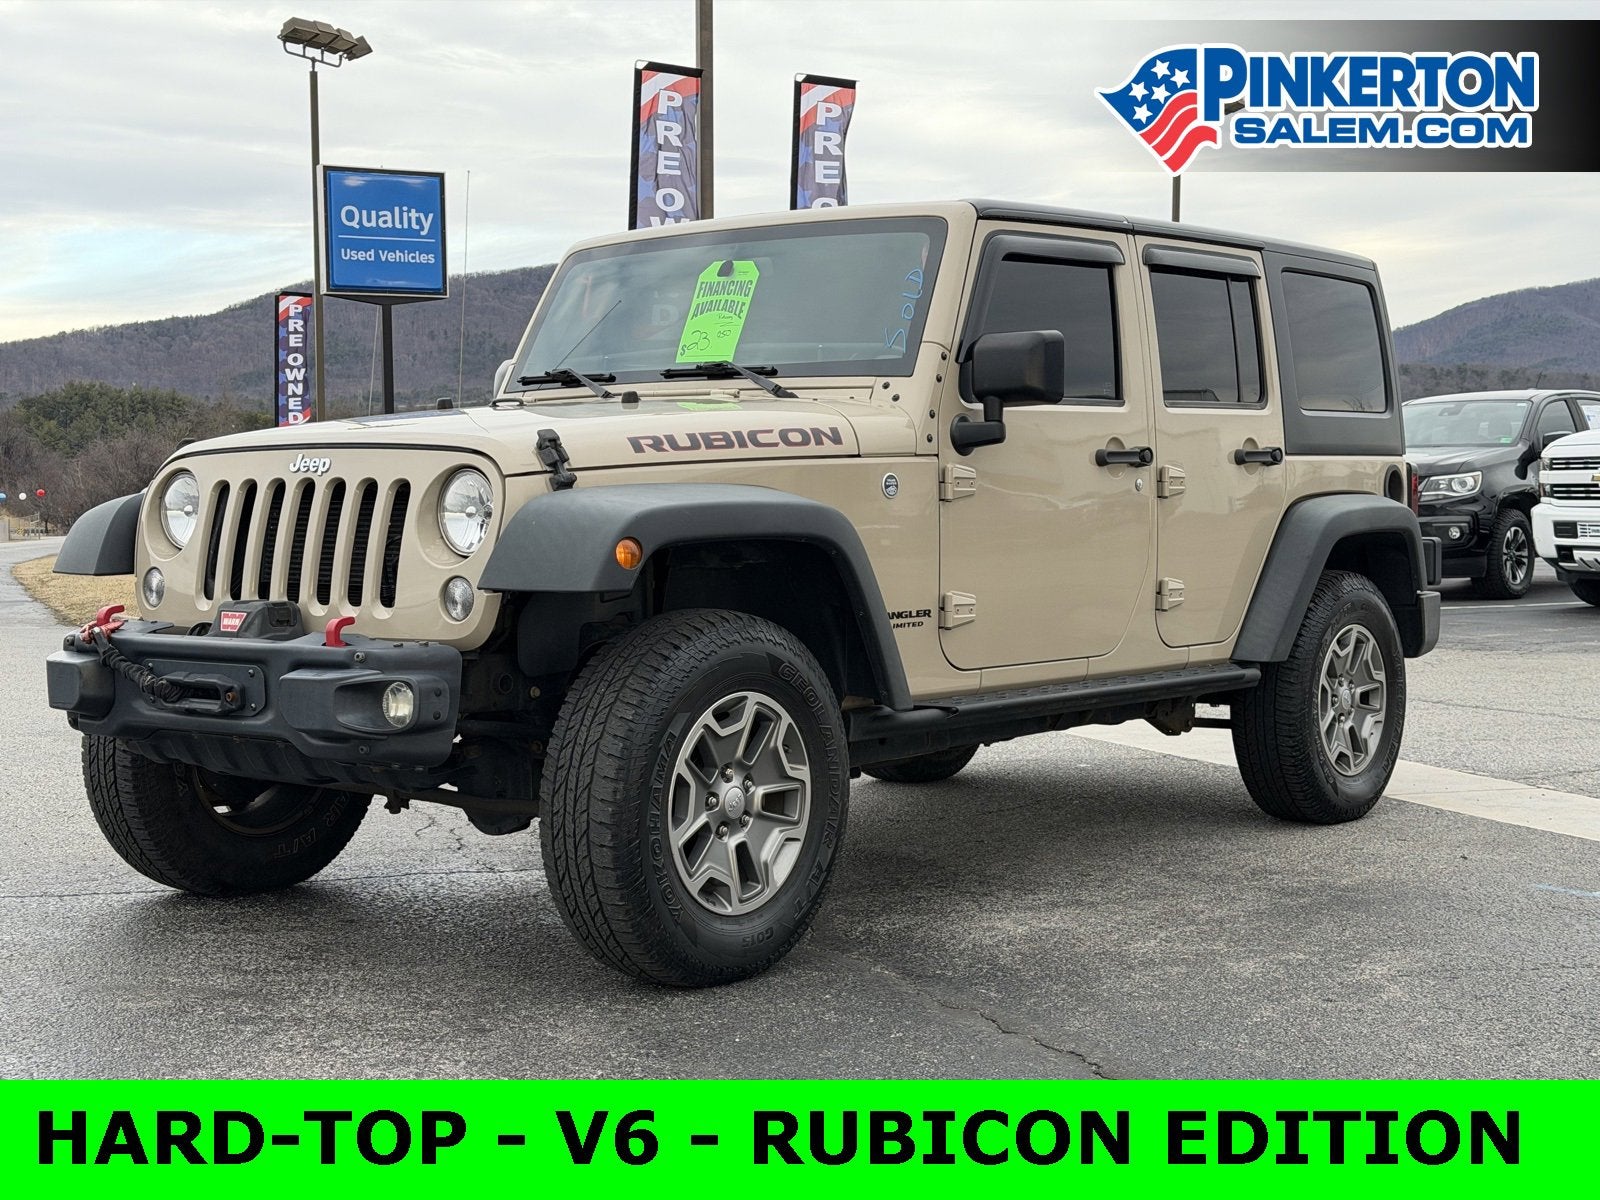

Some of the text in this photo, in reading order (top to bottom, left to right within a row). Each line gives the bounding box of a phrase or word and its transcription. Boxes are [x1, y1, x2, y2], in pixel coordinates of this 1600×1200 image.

[655, 88, 683, 176] PRE
[814, 101, 843, 184] PRE
[340, 205, 434, 236] Quality
[340, 248, 435, 264] Used Vehicles
[690, 299, 746, 321] AVAILABLE
[696, 279, 754, 299] FINANCING
[884, 268, 924, 354] SOLD
[285, 304, 306, 425] PRE OWNED
[289, 453, 331, 477] Jeep
[626, 426, 845, 455] RUBICON
[778, 661, 842, 850] GEOLANDAR
[649, 730, 684, 926] YOKOHAMA
